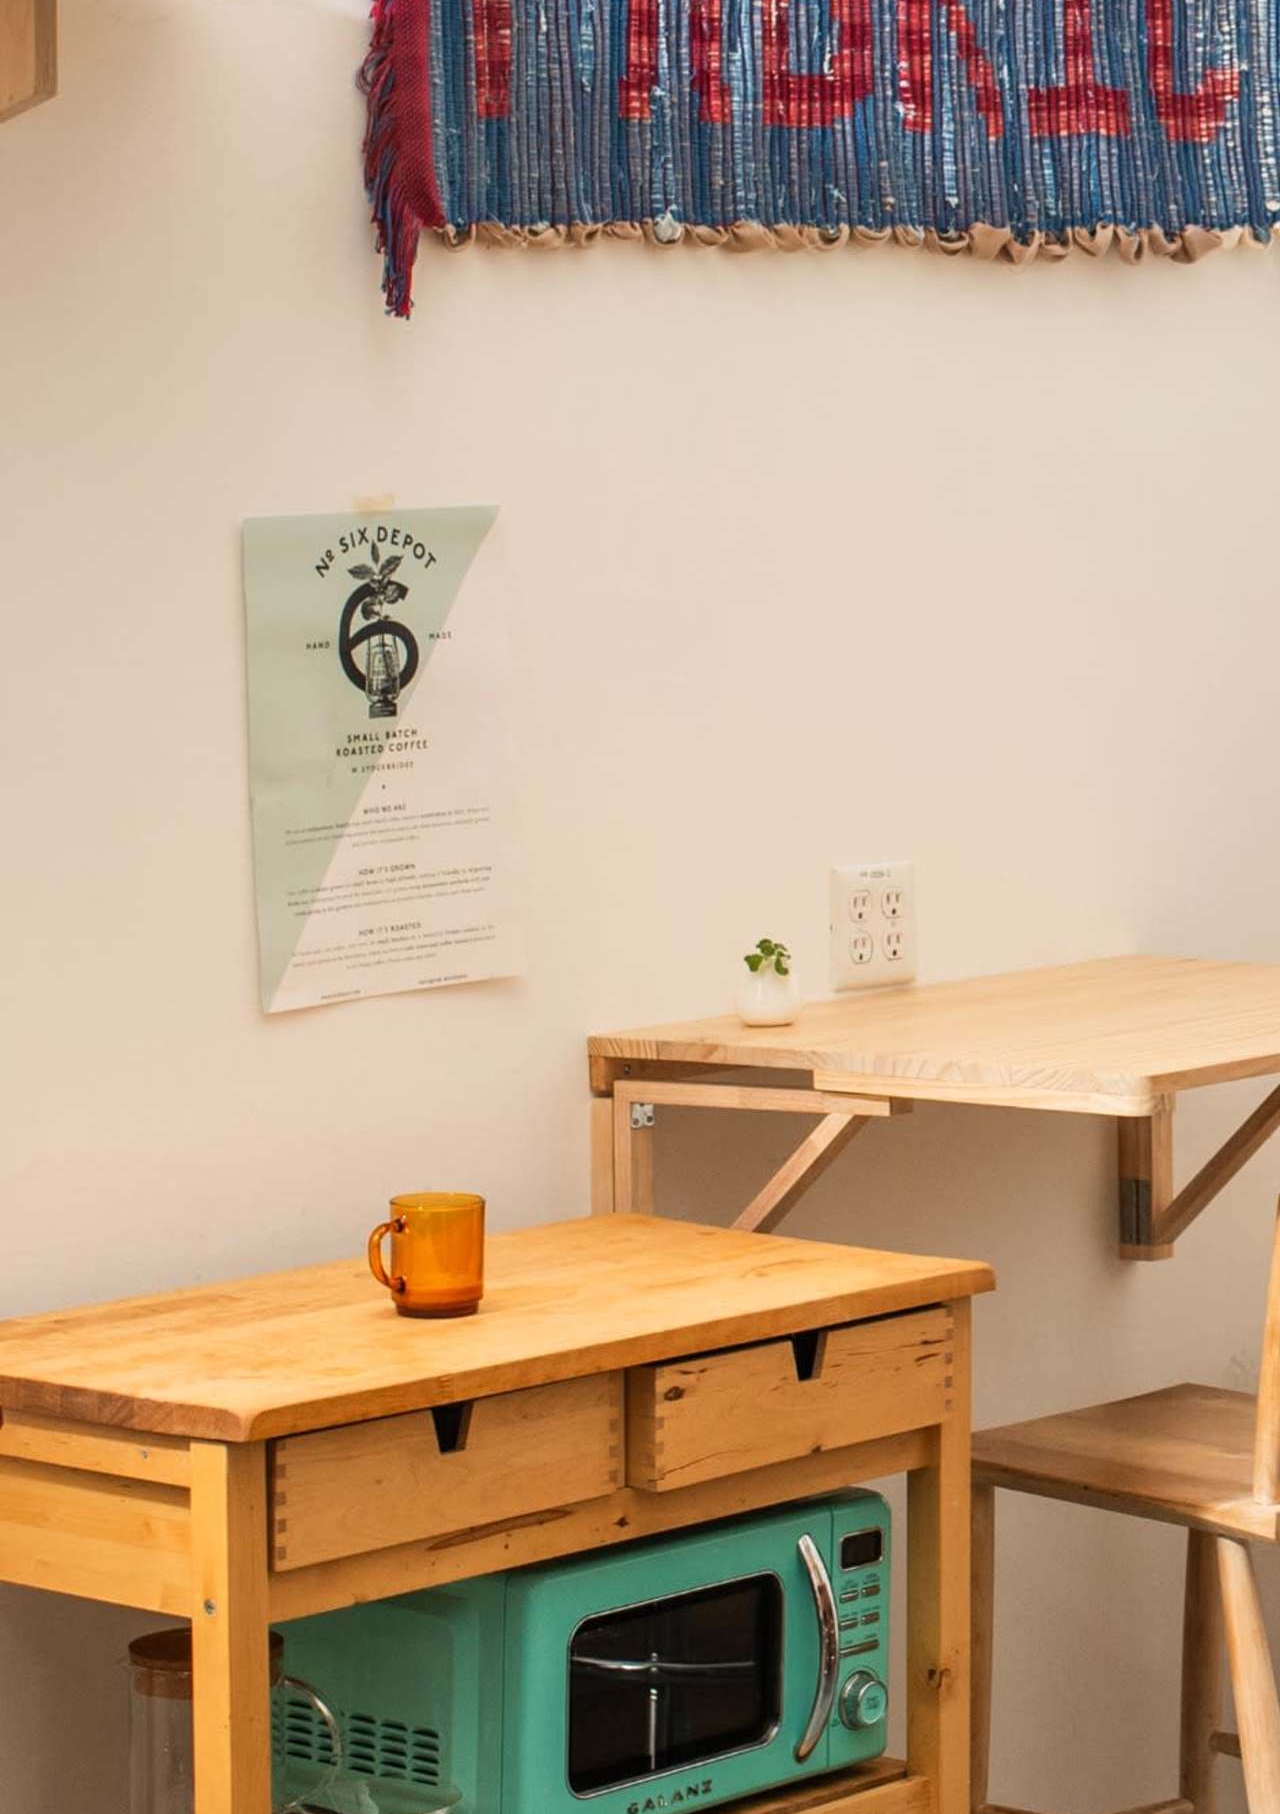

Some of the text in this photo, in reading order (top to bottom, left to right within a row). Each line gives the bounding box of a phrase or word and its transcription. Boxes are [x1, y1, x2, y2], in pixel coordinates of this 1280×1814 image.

[339, 527, 369, 554] SIX
[376, 526, 437, 569] DEPOT
[305, 640, 331, 650] HAND
[347, 728, 418, 744] SMALL BATCH
[335, 739, 429, 757] ROASTED COFFEE
